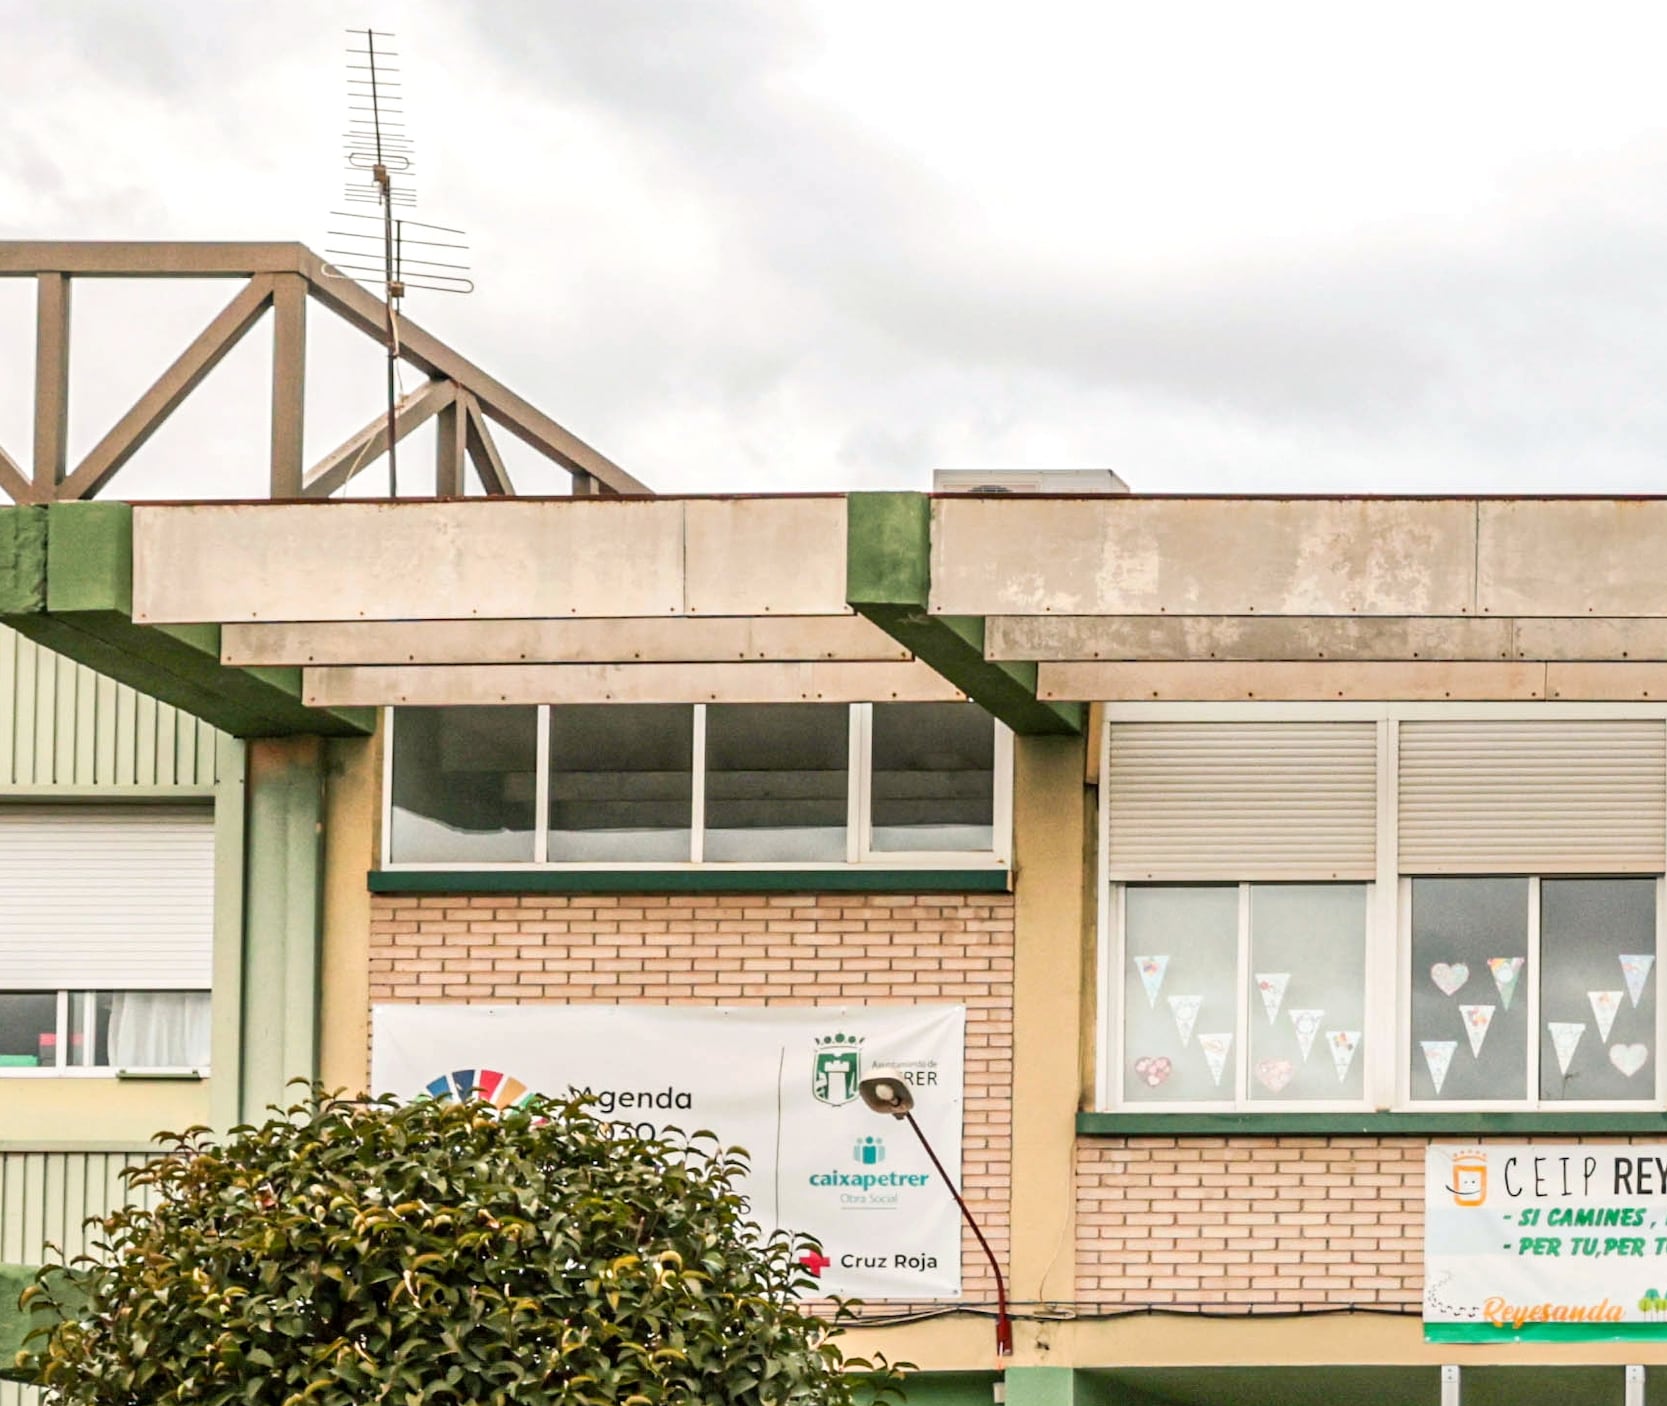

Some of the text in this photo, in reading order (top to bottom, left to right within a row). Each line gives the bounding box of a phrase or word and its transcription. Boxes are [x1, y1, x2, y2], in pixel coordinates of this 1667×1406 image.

[809, 1170, 929, 1191] caixapetrer
[869, 1192, 898, 1203] Social
[1518, 1208, 1541, 1227] SI
[1518, 1237, 1562, 1257] PER
[841, 1252, 938, 1272] Cruz Roja
[1482, 1295, 1625, 1329] Reyesanda
